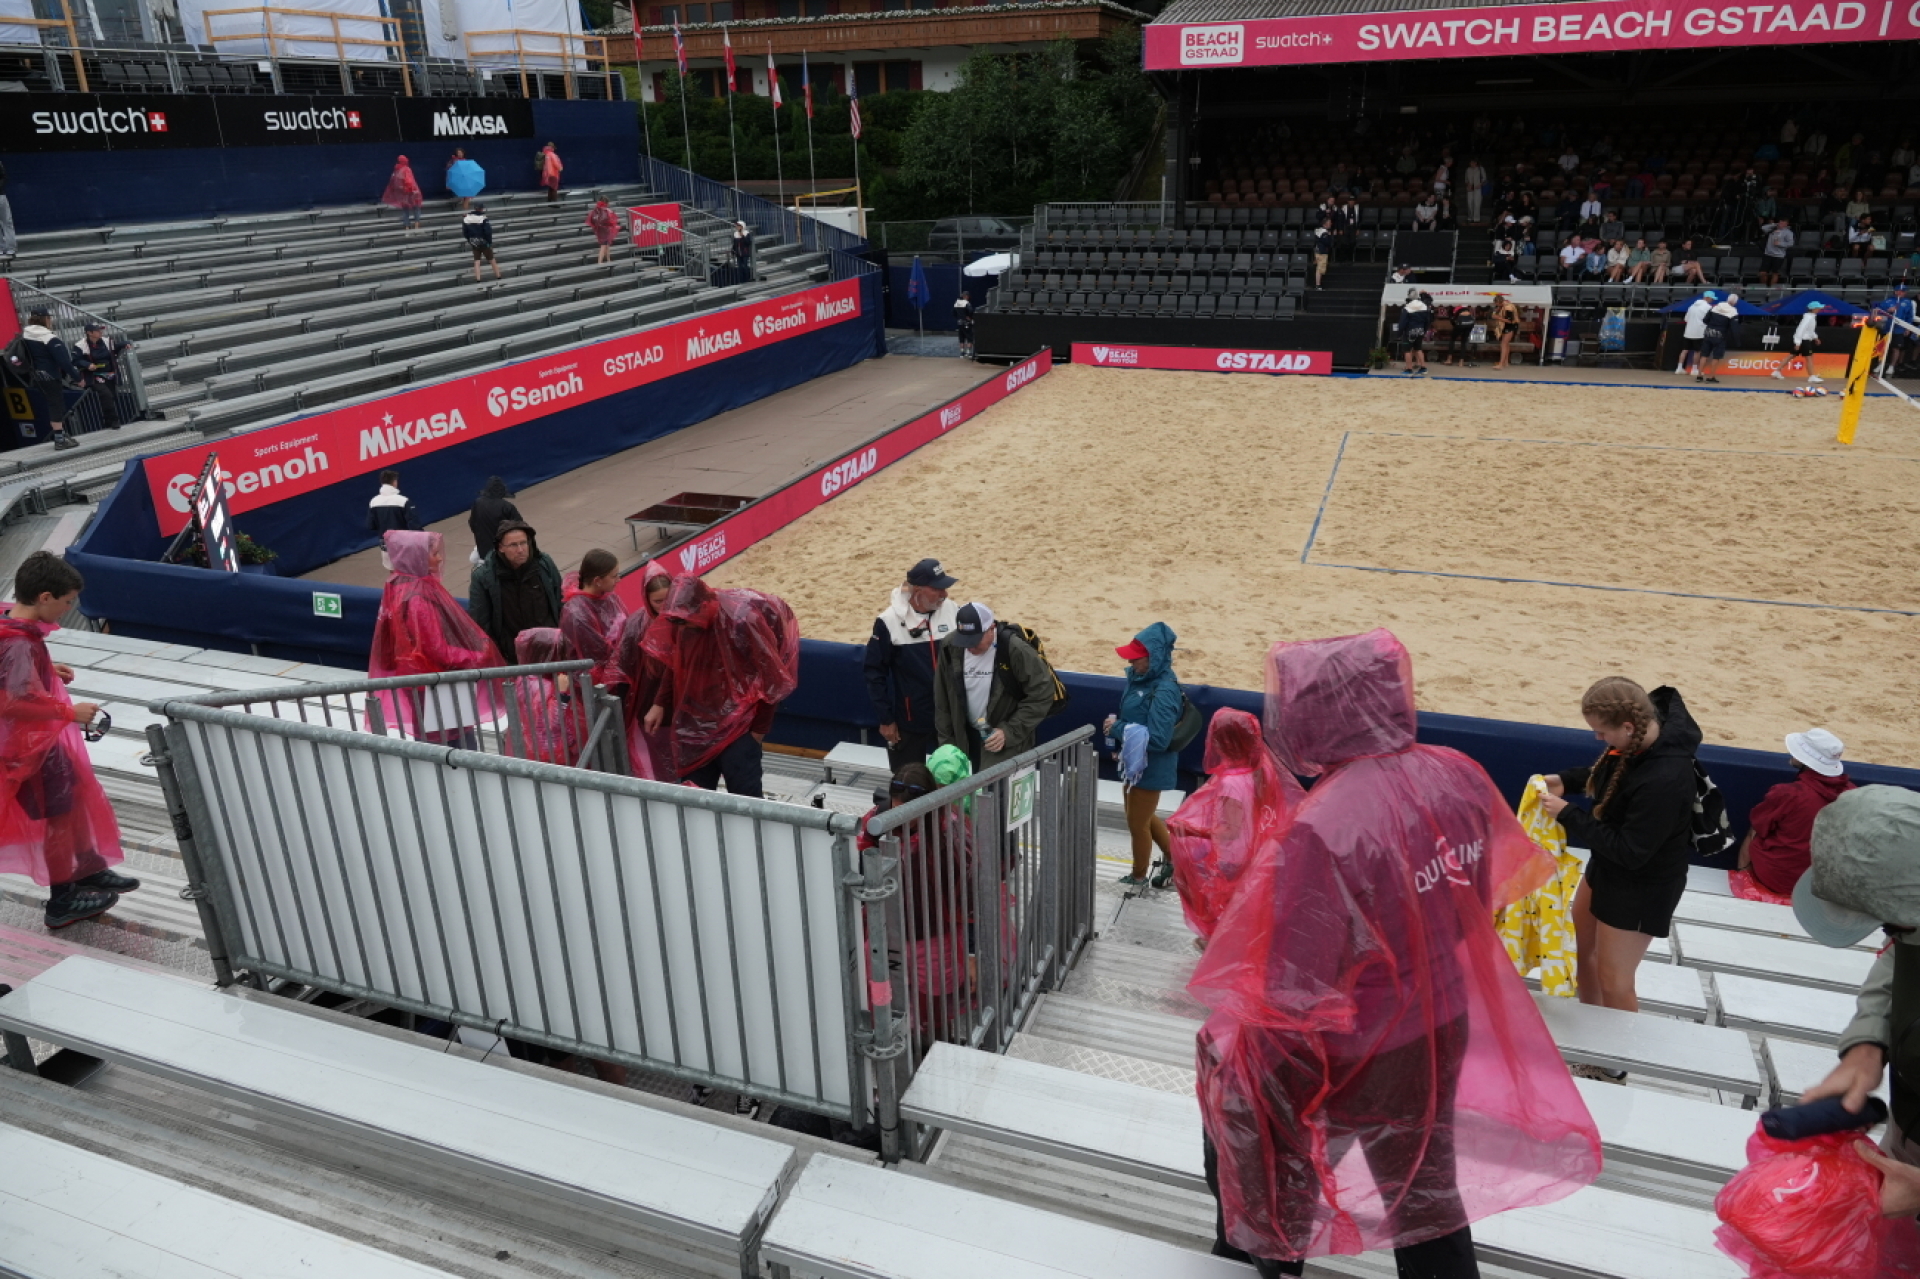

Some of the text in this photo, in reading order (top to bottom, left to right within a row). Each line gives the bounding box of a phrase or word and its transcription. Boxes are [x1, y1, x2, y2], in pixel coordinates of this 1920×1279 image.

[1356, 17, 1521, 50] SWATCH
[1532, 10, 1673, 43] BEACH
[1683, 2, 1866, 36] GSTAAD
[1185, 32, 1239, 47] BEACH
[1255, 32, 1321, 49] swatch
[1185, 47, 1239, 59] GSTAAD
[32, 107, 146, 134] swatch
[263, 107, 346, 131] swatch
[764, 309, 806, 335] Senoh
[603, 345, 664, 377] GSTAAD
[1216, 352, 1311, 371] GSTAAD
[1006, 360, 1038, 392] GSTAAD
[9, 393, 27, 414] B
[510, 371, 584, 411] Senoh
[254, 433, 319, 458] Sports Equipment
[821, 447, 877, 497] GSTAAD
[697, 534, 726, 561] BEACH
